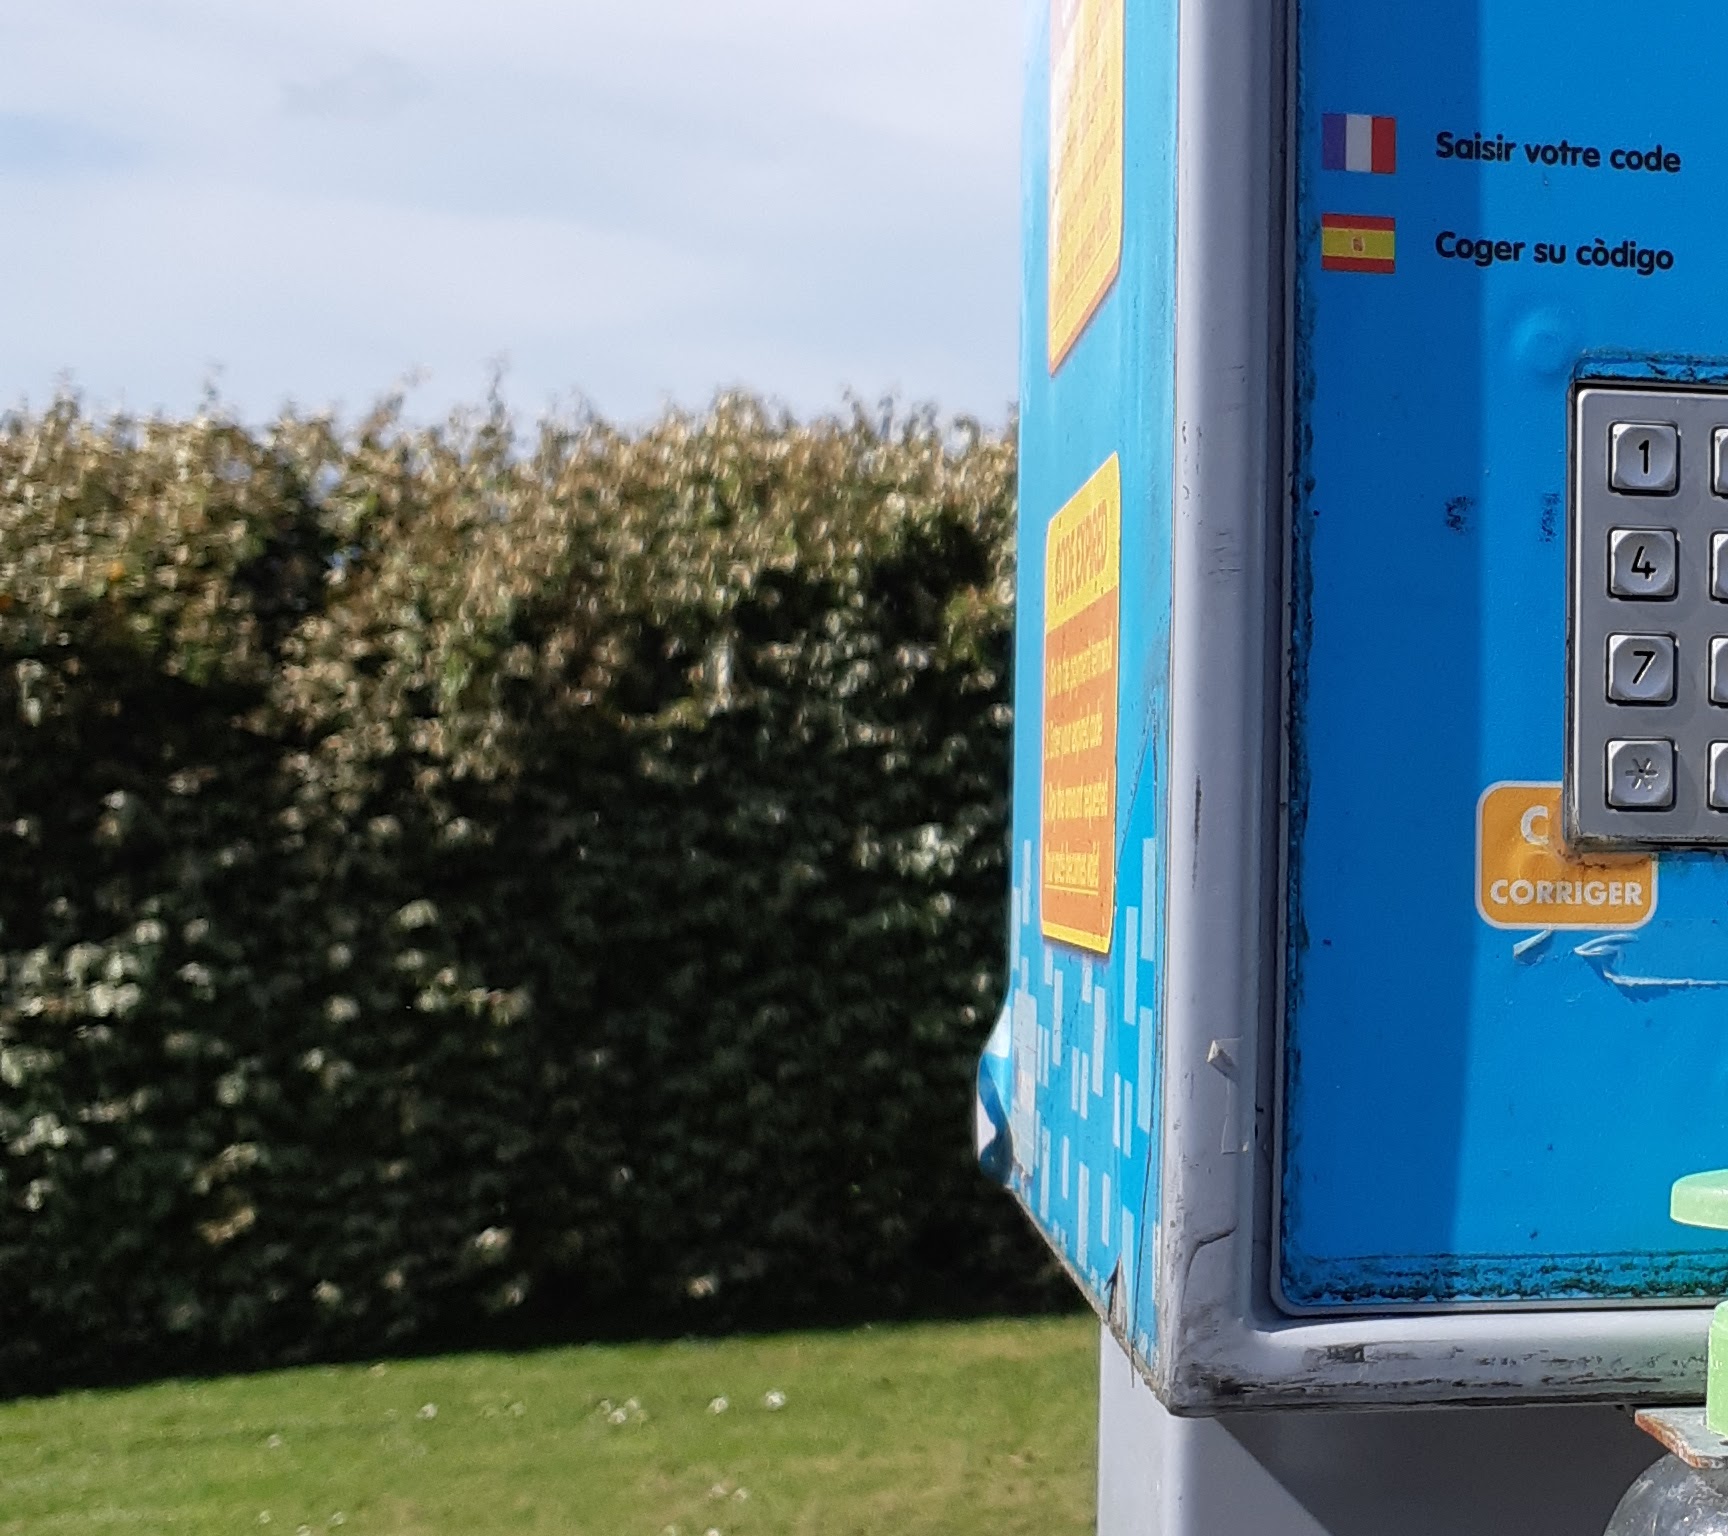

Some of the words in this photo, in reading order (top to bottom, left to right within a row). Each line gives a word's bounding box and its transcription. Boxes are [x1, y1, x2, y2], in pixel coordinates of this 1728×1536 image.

[1436, 131, 1517, 165] Saisir
[1526, 139, 1601, 169] votre
[1609, 144, 1682, 175] code
[1435, 231, 1525, 267] Coger
[1532, 240, 1568, 266] su
[1575, 236, 1675, 275] còdigo
[1638, 440, 1651, 475] 1
[1632, 545, 1657, 580] 4
[1633, 650, 1656, 685] 7
[1520, 805, 1549, 846] C
[1489, 879, 1643, 906] CORRIGER
